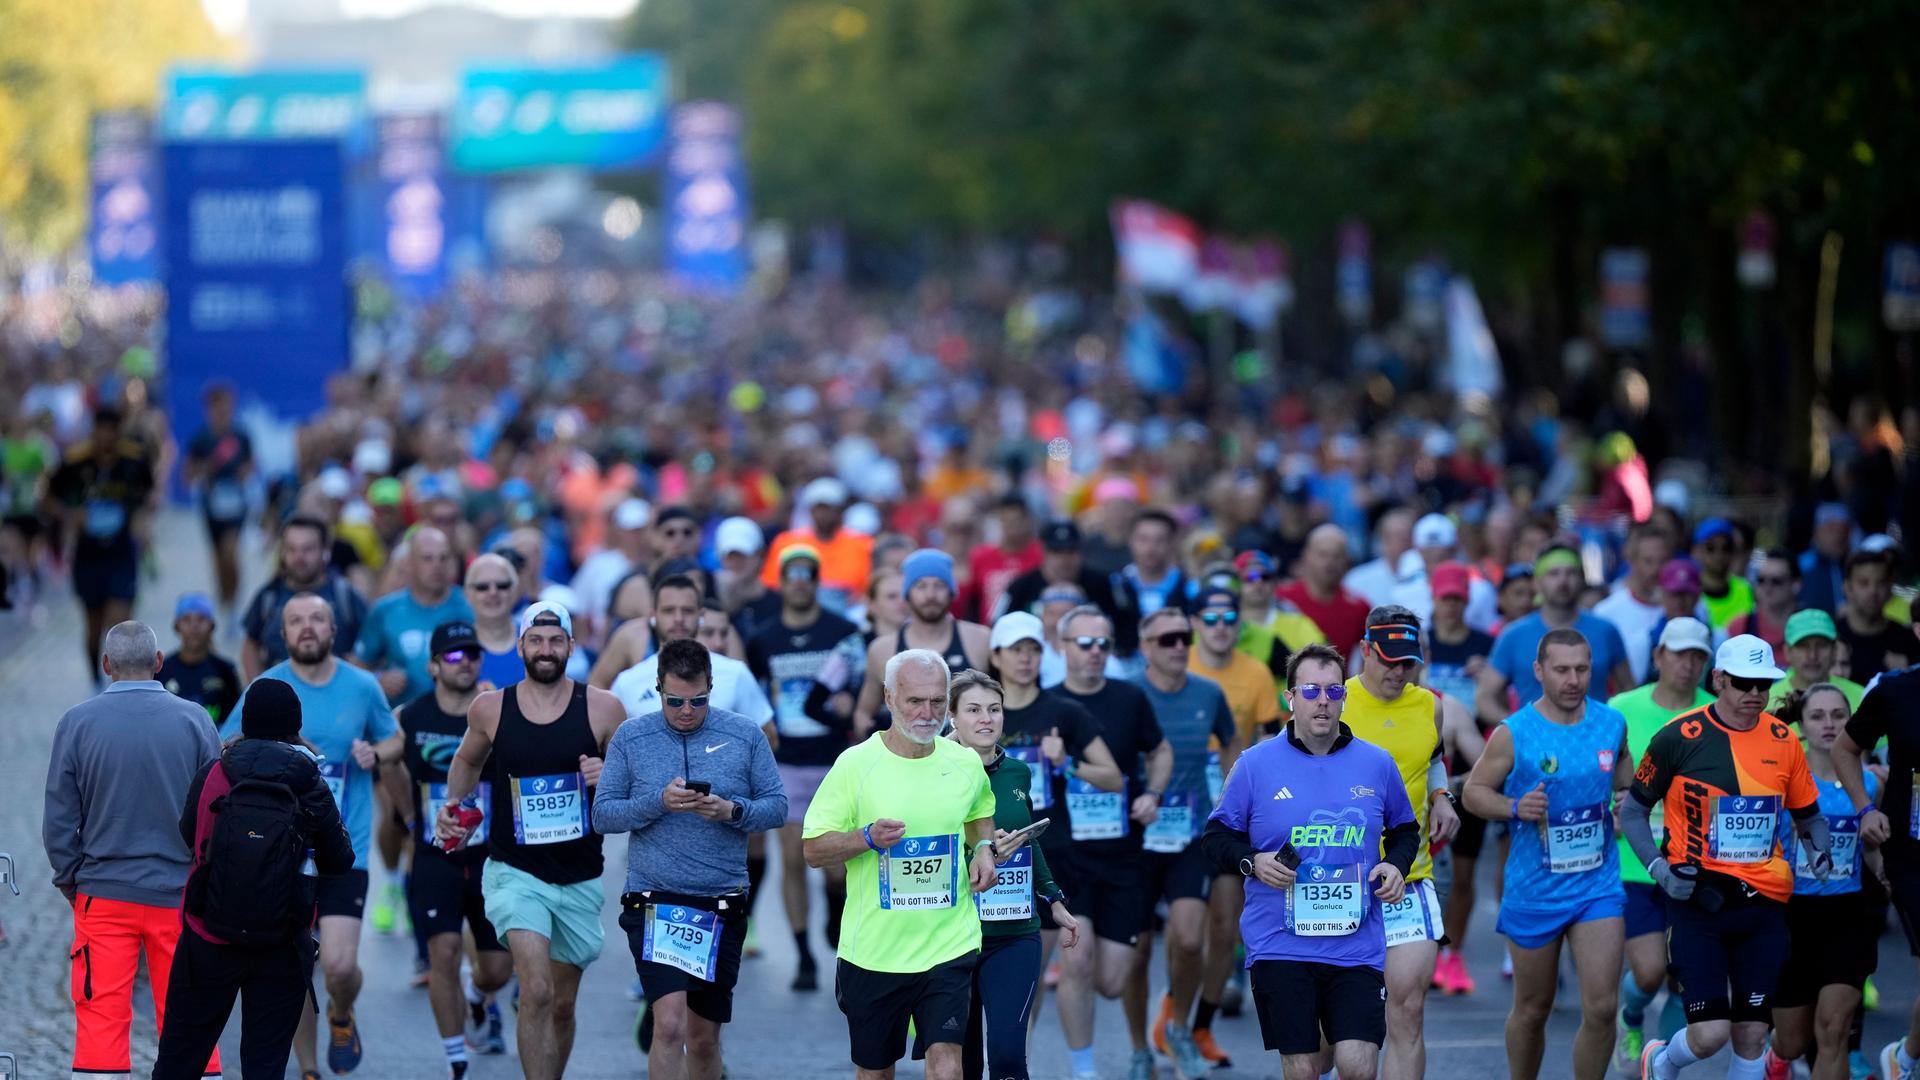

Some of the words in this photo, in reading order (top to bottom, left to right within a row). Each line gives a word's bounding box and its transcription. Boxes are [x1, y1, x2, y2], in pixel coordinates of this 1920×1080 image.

[526, 793, 575, 812] 59837
[1725, 816, 1770, 830] 89071
[526, 832, 538, 840] YOU
[540, 830, 552, 838] GOT
[553, 829, 568, 837] THIS
[1290, 825, 1366, 847] BERLIN
[1555, 823, 1598, 843] 33497
[902, 858, 942, 875] 3267
[997, 870, 1028, 885] 6381
[1301, 885, 1353, 900] 13345
[892, 897, 906, 905] YOU
[907, 897, 921, 905] GOT
[923, 896, 938, 904] THIS
[1384, 897, 1413, 914] 309
[981, 908, 995, 916] YOU
[996, 907, 1008, 915] GOT
[1009, 907, 1021, 915] THIS
[664, 923, 703, 945] 17139
[1296, 923, 1310, 931] YOU
[1312, 923, 1326, 931] GOT
[1327, 922, 1343, 931] THIS
[1395, 930, 1409, 939] THIS
[672, 939, 691, 951] Robert
[654, 950, 668, 960] YOU
[668, 955, 680, 963] GOT
[680, 959, 692, 970] THIS
